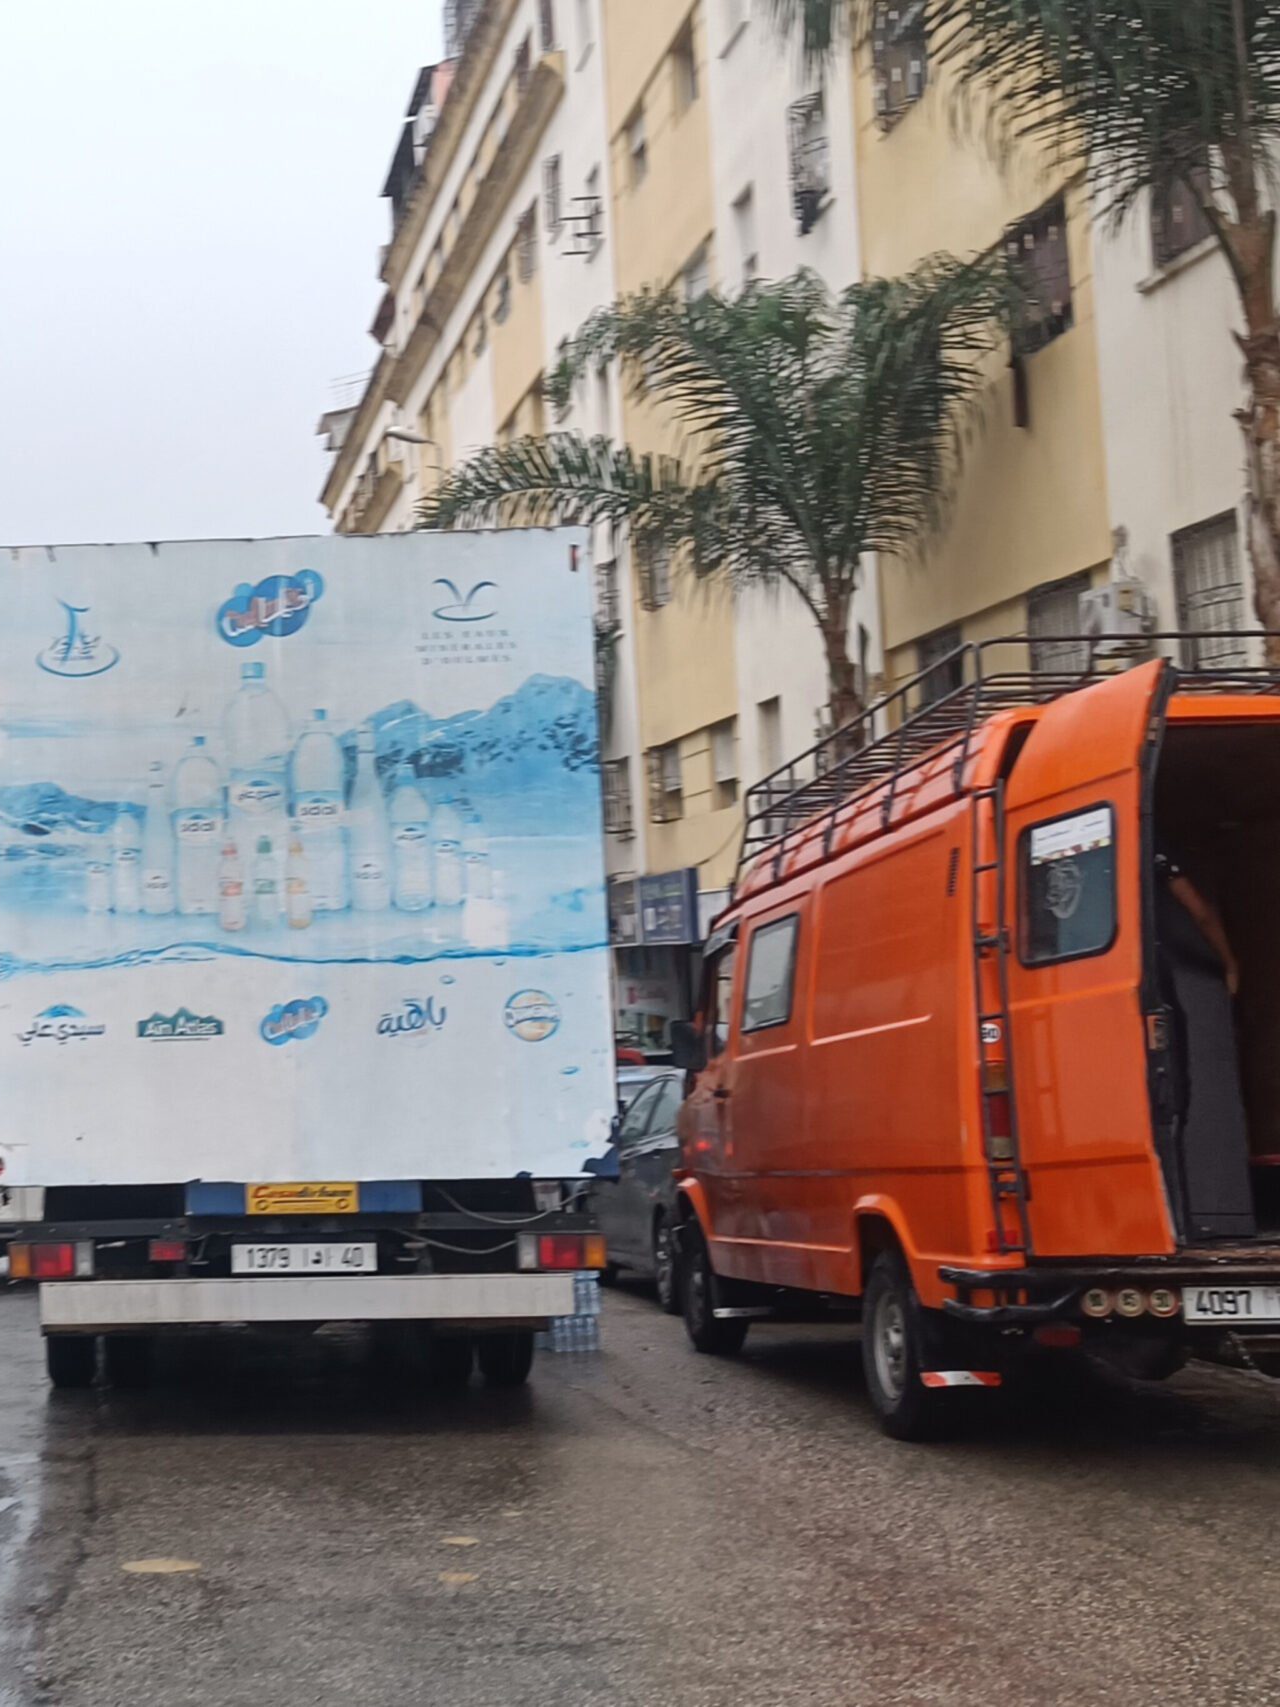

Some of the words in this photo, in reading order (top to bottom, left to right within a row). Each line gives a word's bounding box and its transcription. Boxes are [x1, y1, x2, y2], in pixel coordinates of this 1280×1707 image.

[174, 1016, 217, 1035] Atlas
[247, 1247, 290, 1269] 1379
[341, 1246, 363, 1268] 40
[1196, 1290, 1252, 1315] 4097
